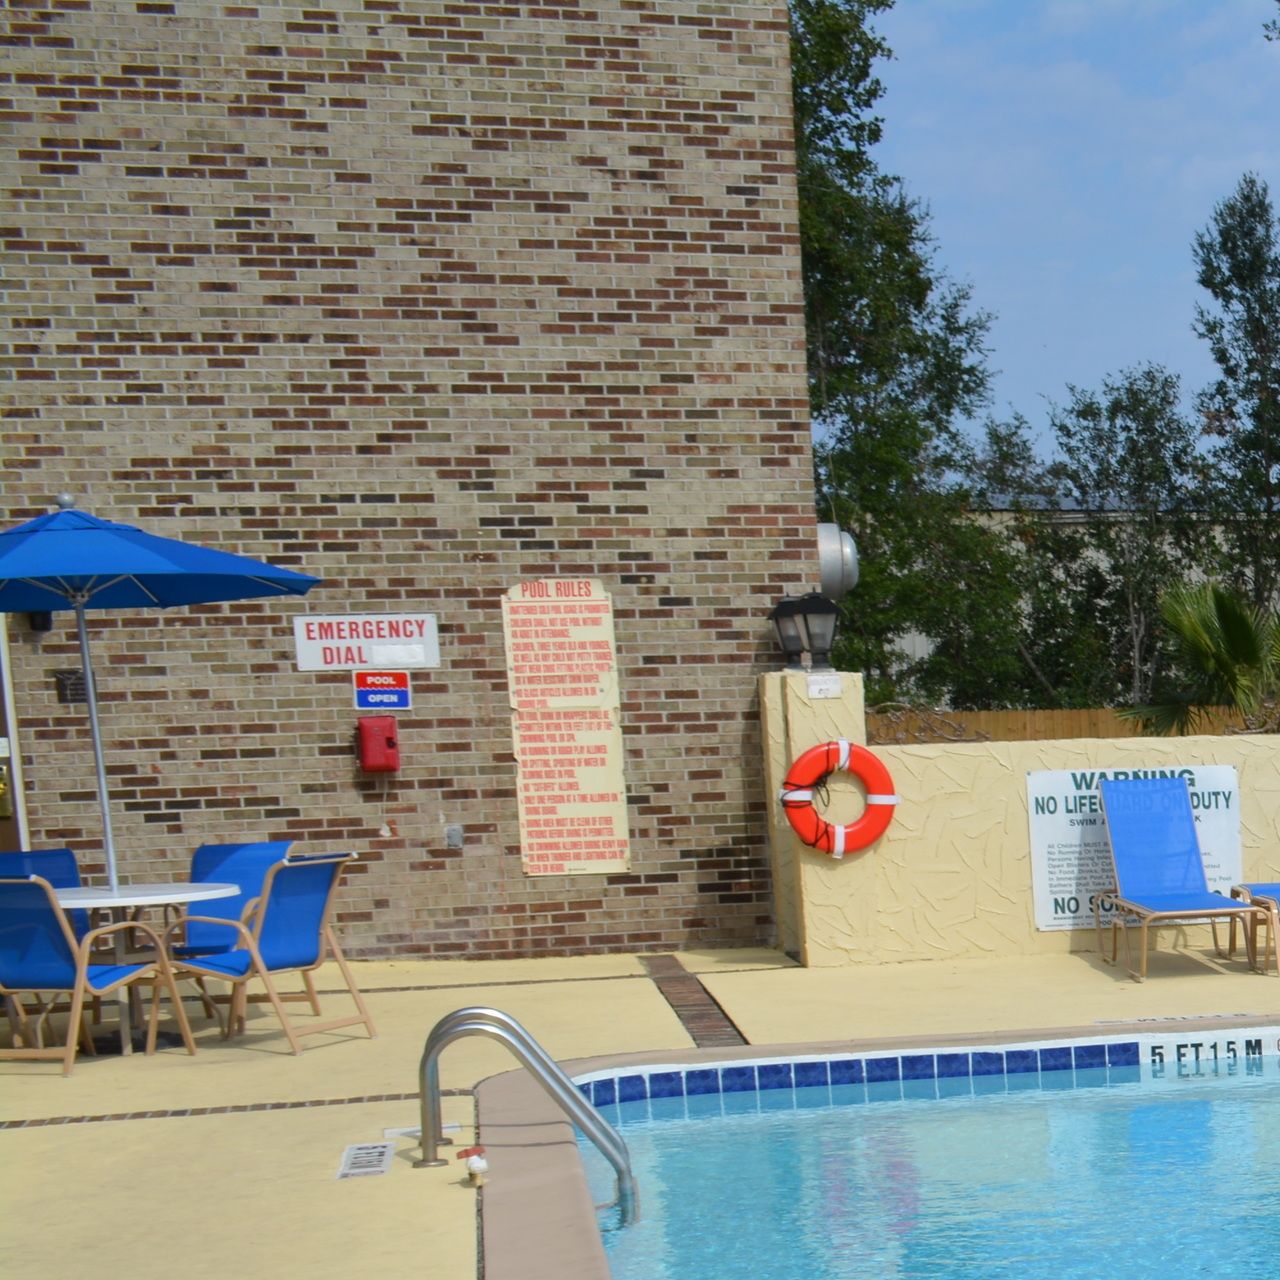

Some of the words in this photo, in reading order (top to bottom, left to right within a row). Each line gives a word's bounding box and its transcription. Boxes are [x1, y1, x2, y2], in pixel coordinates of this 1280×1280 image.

[521, 581, 551, 598] POOL
[555, 580, 592, 598] RULES
[305, 619, 425, 640] EMERGENCY
[322, 646, 368, 665] DIAL
[366, 676, 397, 685] POOL
[368, 694, 398, 703] OPEN
[1034, 796, 1057, 815] NO
[1190, 791, 1232, 810] DUTY
[1069, 818, 1097, 827] SWIM
[1054, 897, 1079, 914] NO
[1151, 1046, 1164, 1063] 5
